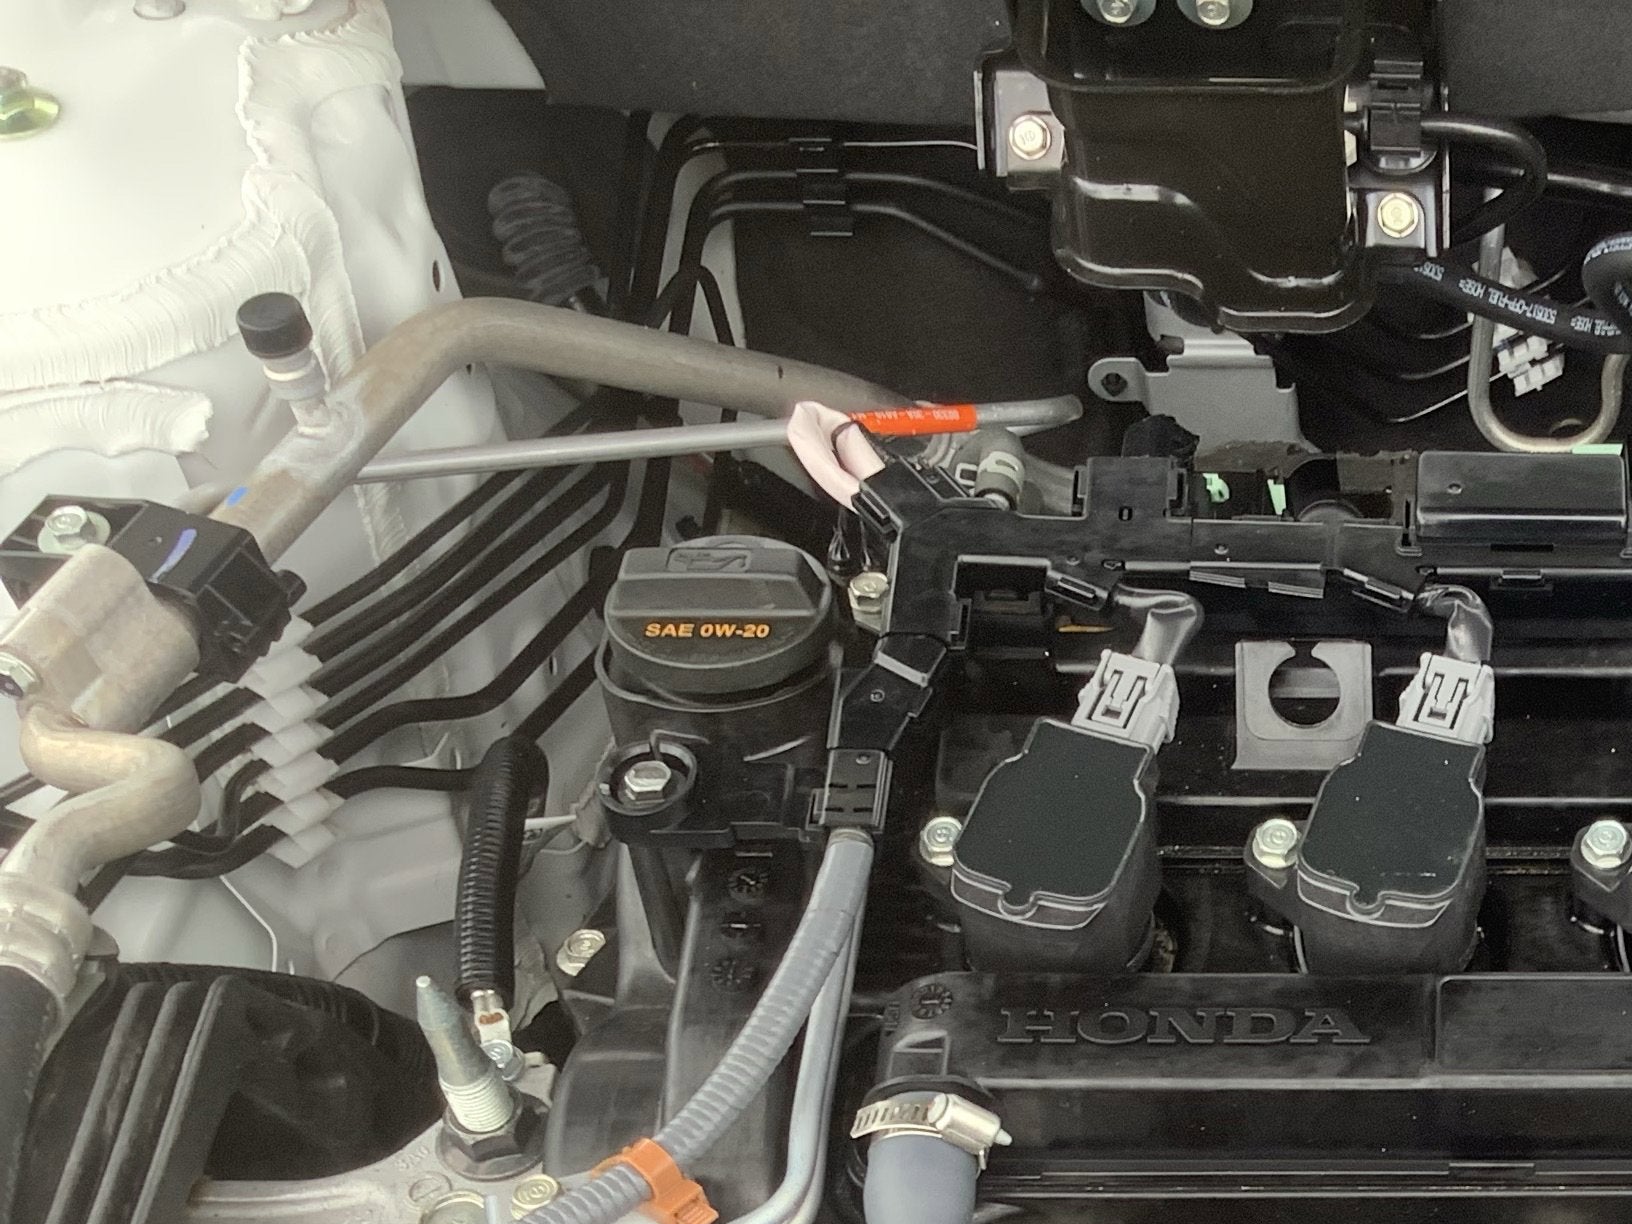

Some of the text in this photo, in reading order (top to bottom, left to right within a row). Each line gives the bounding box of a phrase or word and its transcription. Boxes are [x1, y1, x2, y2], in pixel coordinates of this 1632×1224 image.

[645, 622, 771, 639] SAE 0W-20
[997, 1006, 1371, 1046] HONDA
